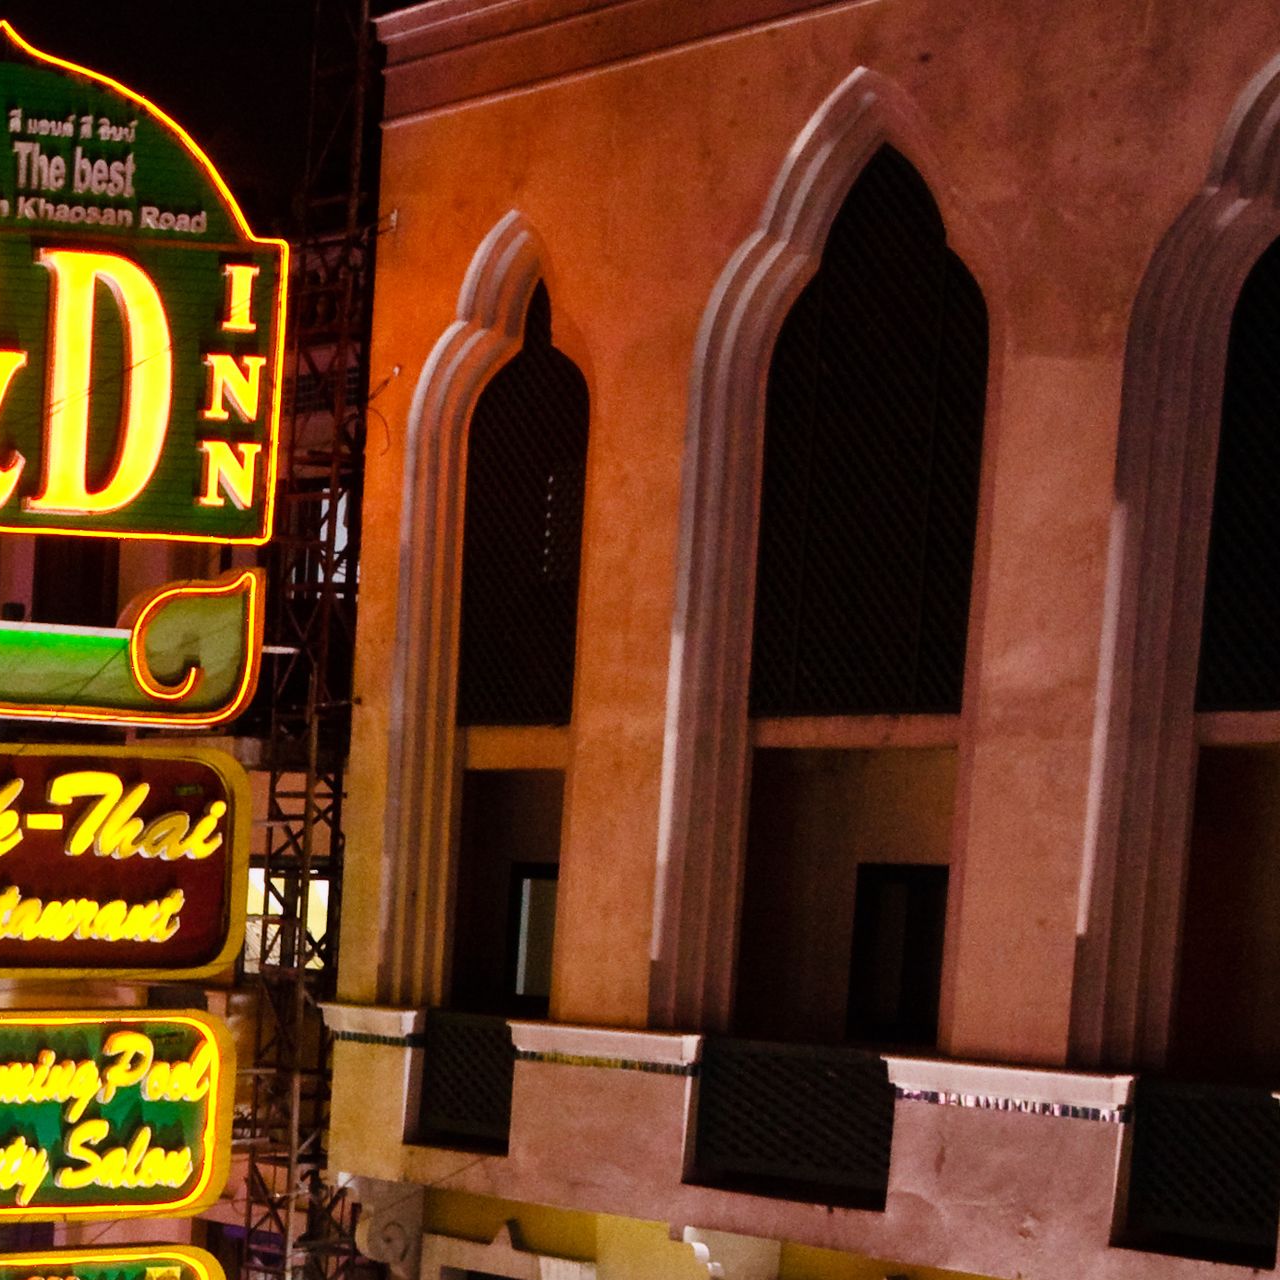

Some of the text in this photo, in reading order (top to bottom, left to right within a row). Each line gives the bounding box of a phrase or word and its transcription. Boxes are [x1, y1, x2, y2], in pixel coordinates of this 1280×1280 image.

[12, 141, 136, 198] The best
[16, 196, 134, 228] Khaosan
[140, 206, 208, 233] Road
[100, 1030, 214, 1104] Pool
[55, 1120, 194, 1190] Salon
